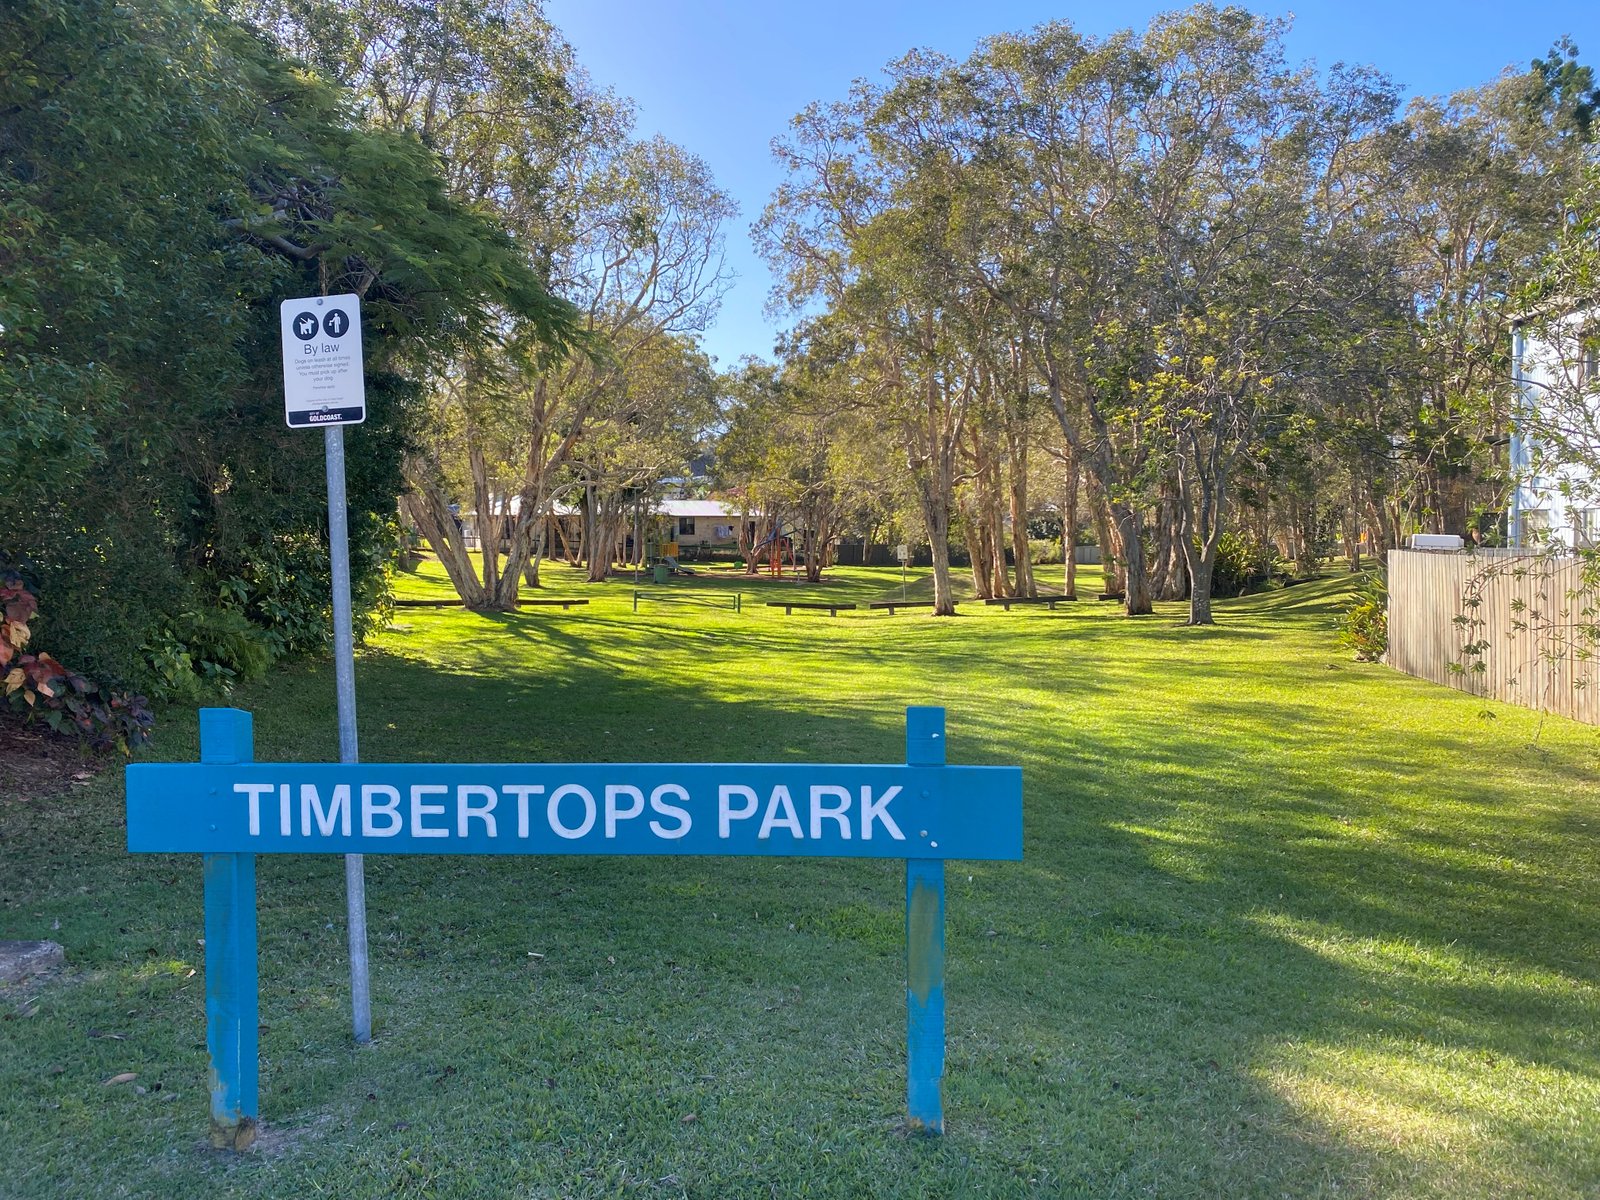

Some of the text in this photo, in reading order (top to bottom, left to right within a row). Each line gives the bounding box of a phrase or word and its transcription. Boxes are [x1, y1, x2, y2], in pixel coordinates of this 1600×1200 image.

[304, 342, 340, 356] By law
[233, 783, 906, 840] TIMBERTOPS PARK
